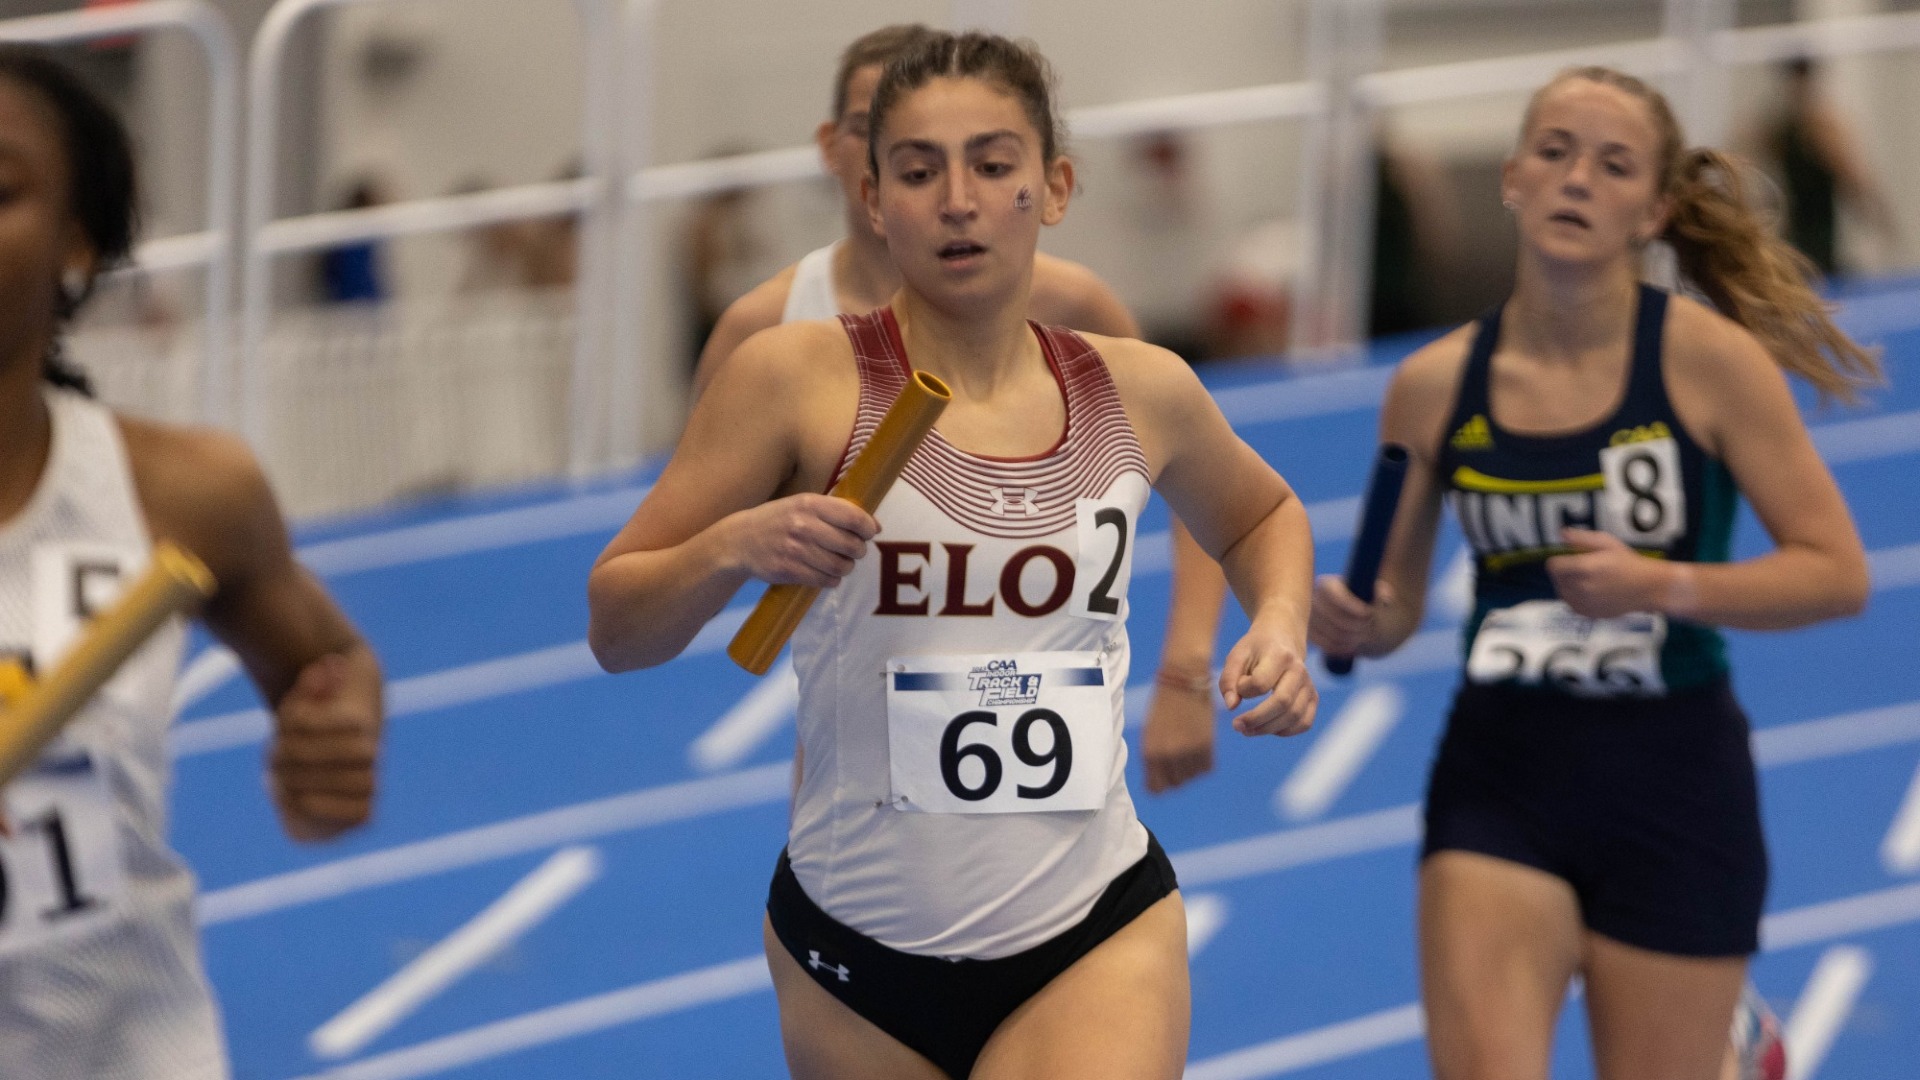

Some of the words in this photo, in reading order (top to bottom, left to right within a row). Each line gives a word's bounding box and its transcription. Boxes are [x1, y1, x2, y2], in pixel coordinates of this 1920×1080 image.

[1622, 452, 1664, 534] 8
[872, 541, 1076, 618] ELO
[1087, 507, 1127, 615] 2
[968, 672, 1022, 690] TRACK
[979, 687, 1038, 706] FIELD
[987, 659, 1017, 671] CAA
[939, 708, 1073, 801] 69
